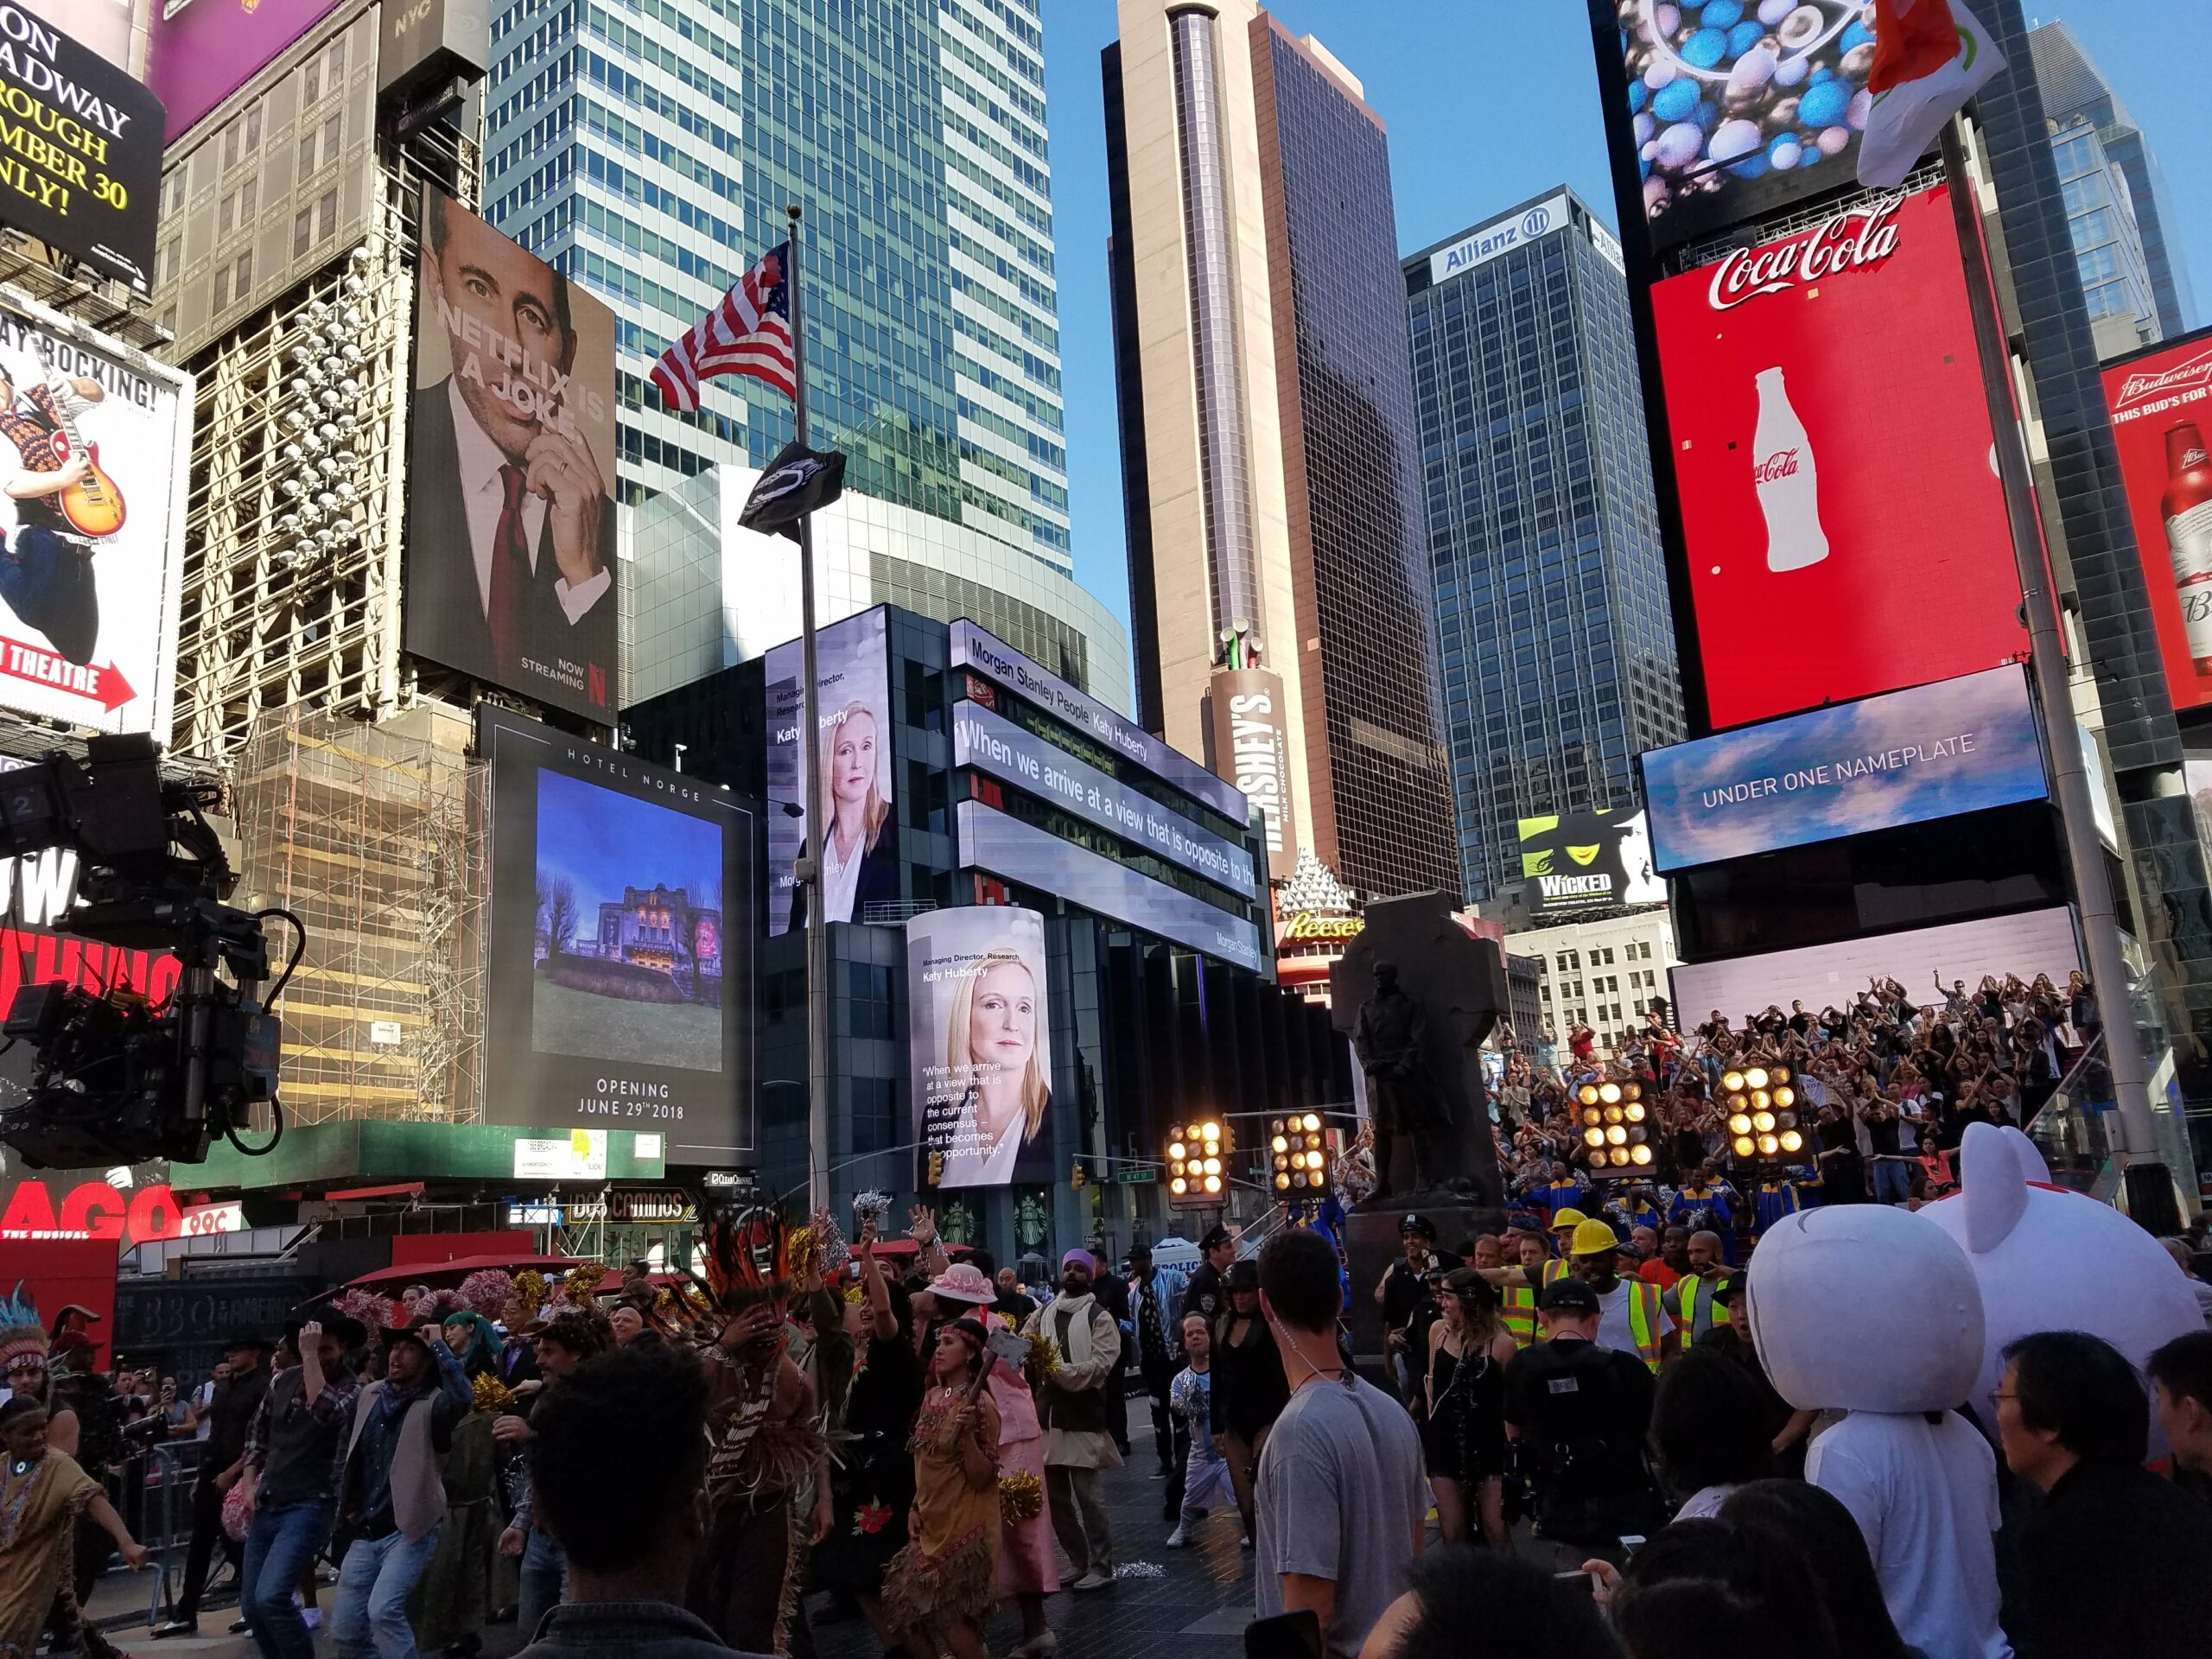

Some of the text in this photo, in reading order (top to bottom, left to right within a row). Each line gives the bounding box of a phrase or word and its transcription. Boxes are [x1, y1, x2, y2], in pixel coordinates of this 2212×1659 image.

[92, 173, 128, 210] 30
[1446, 226, 1518, 273] Allianz
[1709, 195, 1906, 309] Coca-Cola
[437, 296, 604, 423] NETFLIX IS
[461, 352, 486, 389] A
[2112, 408, 2141, 424] THIS
[2143, 396, 2181, 415] BUD'S
[2182, 387, 2208, 404] FOR
[10, 645, 100, 694] THEATRE
[521, 657, 584, 690] STREAMING
[558, 658, 584, 677] NOW
[972, 638, 1147, 761] Morgan Stanley People Katy Huberty
[777, 726, 801, 744] Katy
[1276, 728, 1287, 793] CHOCOLATE
[1703, 733, 1977, 809] UNDER ONE NAMEPLATE
[568, 748, 699, 802] HOTEL NORGE
[1016, 751, 1040, 779] we
[1045, 766, 1084, 803] arrive
[1088, 786, 1102, 811] at
[1105, 797, 1113, 817] a
[1116, 800, 1144, 833] view
[1147, 814, 1170, 846] that
[1173, 825, 1183, 852] is
[1185, 839, 1229, 874] opposite
[1230, 858, 1241, 881] to
[923, 956, 952, 967] Managing
[954, 953, 985, 962] Director,
[923, 967, 988, 982] Katy Huberty
[973, 1060, 1001, 1071] arrive
[596, 1077, 670, 1099] OPENING
[926, 1081, 934, 1090] at
[944, 1077, 966, 1087] view
[969, 1075, 989, 1085] that
[993, 1074, 1001, 1084] is
[577, 1097, 620, 1116] JUNE
[652, 1103, 683, 1120] 2018
[926, 1090, 979, 1105] opposite to
[927, 1103, 978, 1118] the current
[927, 1119, 978, 1132] consensus
[945, 1132, 994, 1144] becomes
[573, 1192, 607, 1218] DOS
[2, 1229, 91, 1240] THE MUSICAL
